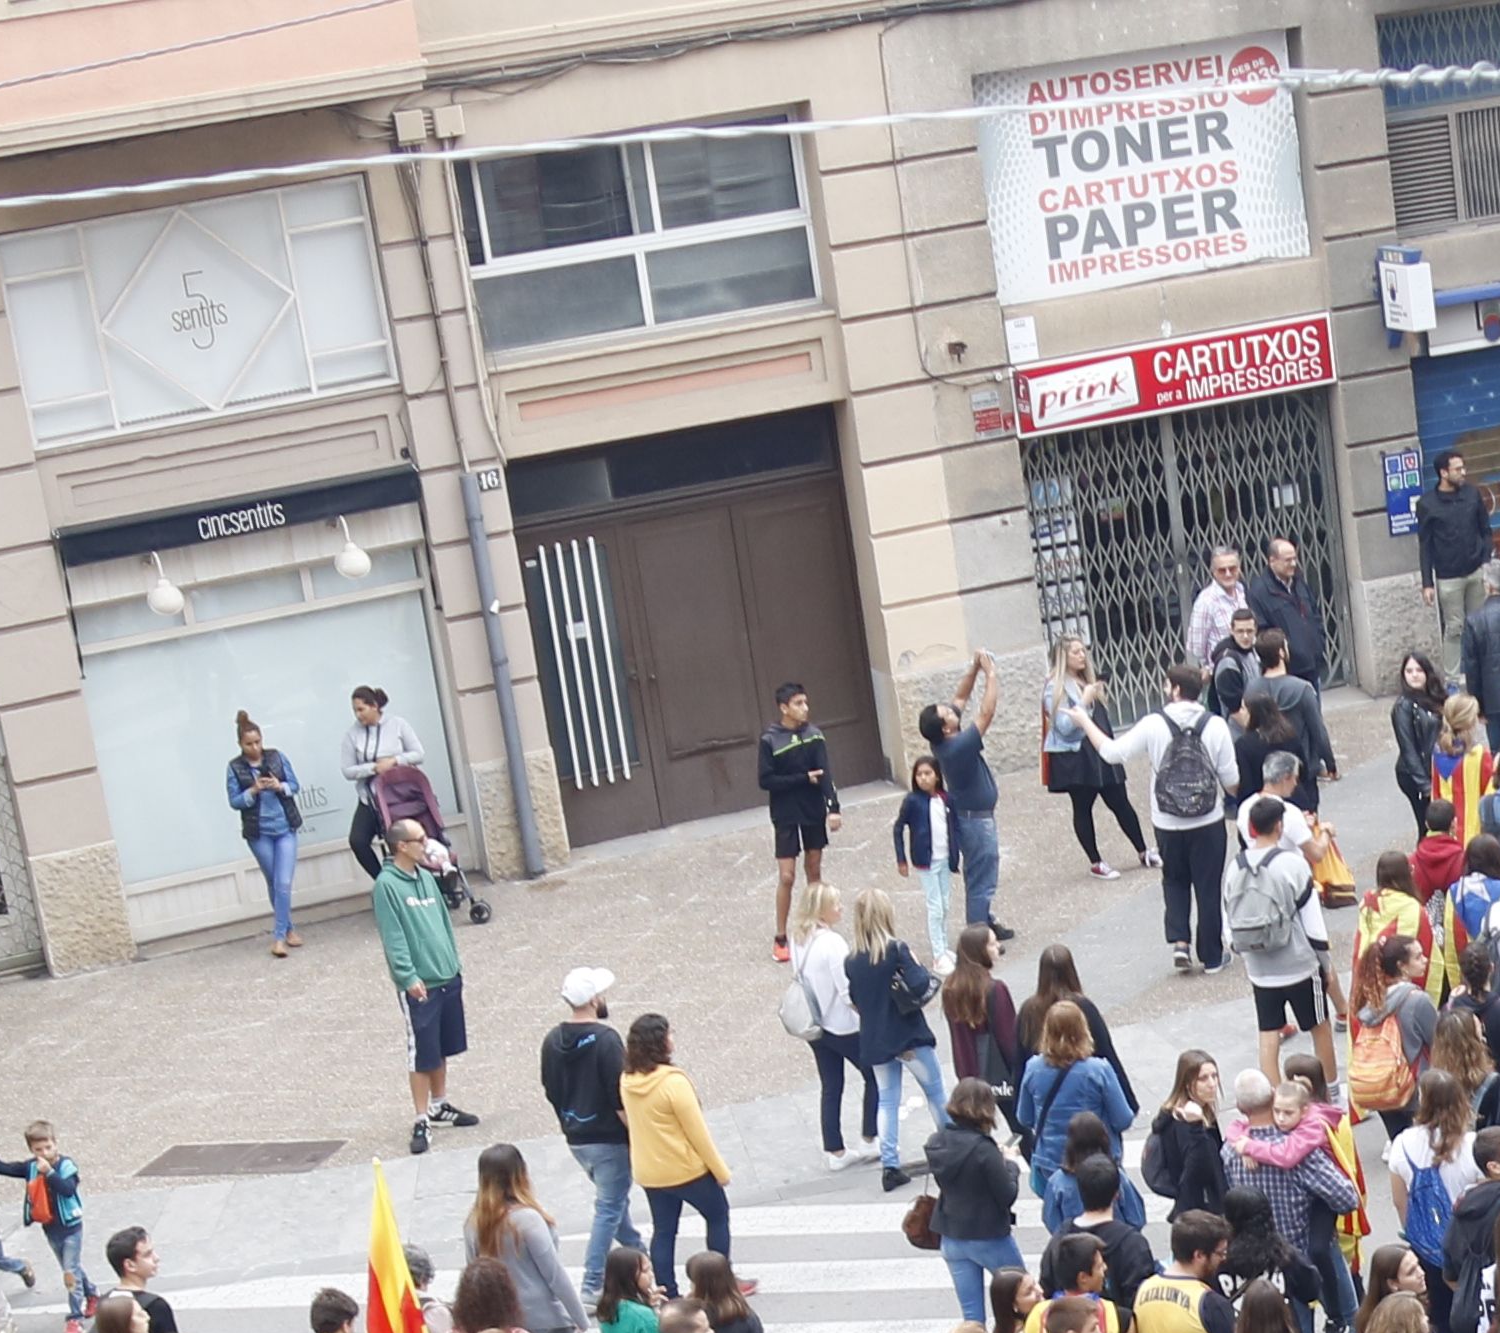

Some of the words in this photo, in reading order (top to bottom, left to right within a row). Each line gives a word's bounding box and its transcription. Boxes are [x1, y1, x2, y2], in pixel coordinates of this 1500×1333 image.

[1026, 55, 1224, 105] AUTOSERVEI
[1252, 56, 1267, 71] DE
[1031, 110, 1235, 179] TONER
[1037, 159, 1240, 214] CARTUTXOS
[1044, 187, 1244, 261] PAPER
[1047, 231, 1249, 285] IMPRESSORES
[1152, 325, 1321, 385] CARTUTXOS
[1037, 371, 1131, 420] prink
[1156, 387, 1175, 406] per
[1175, 388, 1184, 402] a
[1184, 356, 1324, 402] IMPRESSORES
[480, 471, 499, 490] 16
[196, 500, 287, 542] cincsentits
[1139, 1286, 1192, 1309] CATALUNYA
